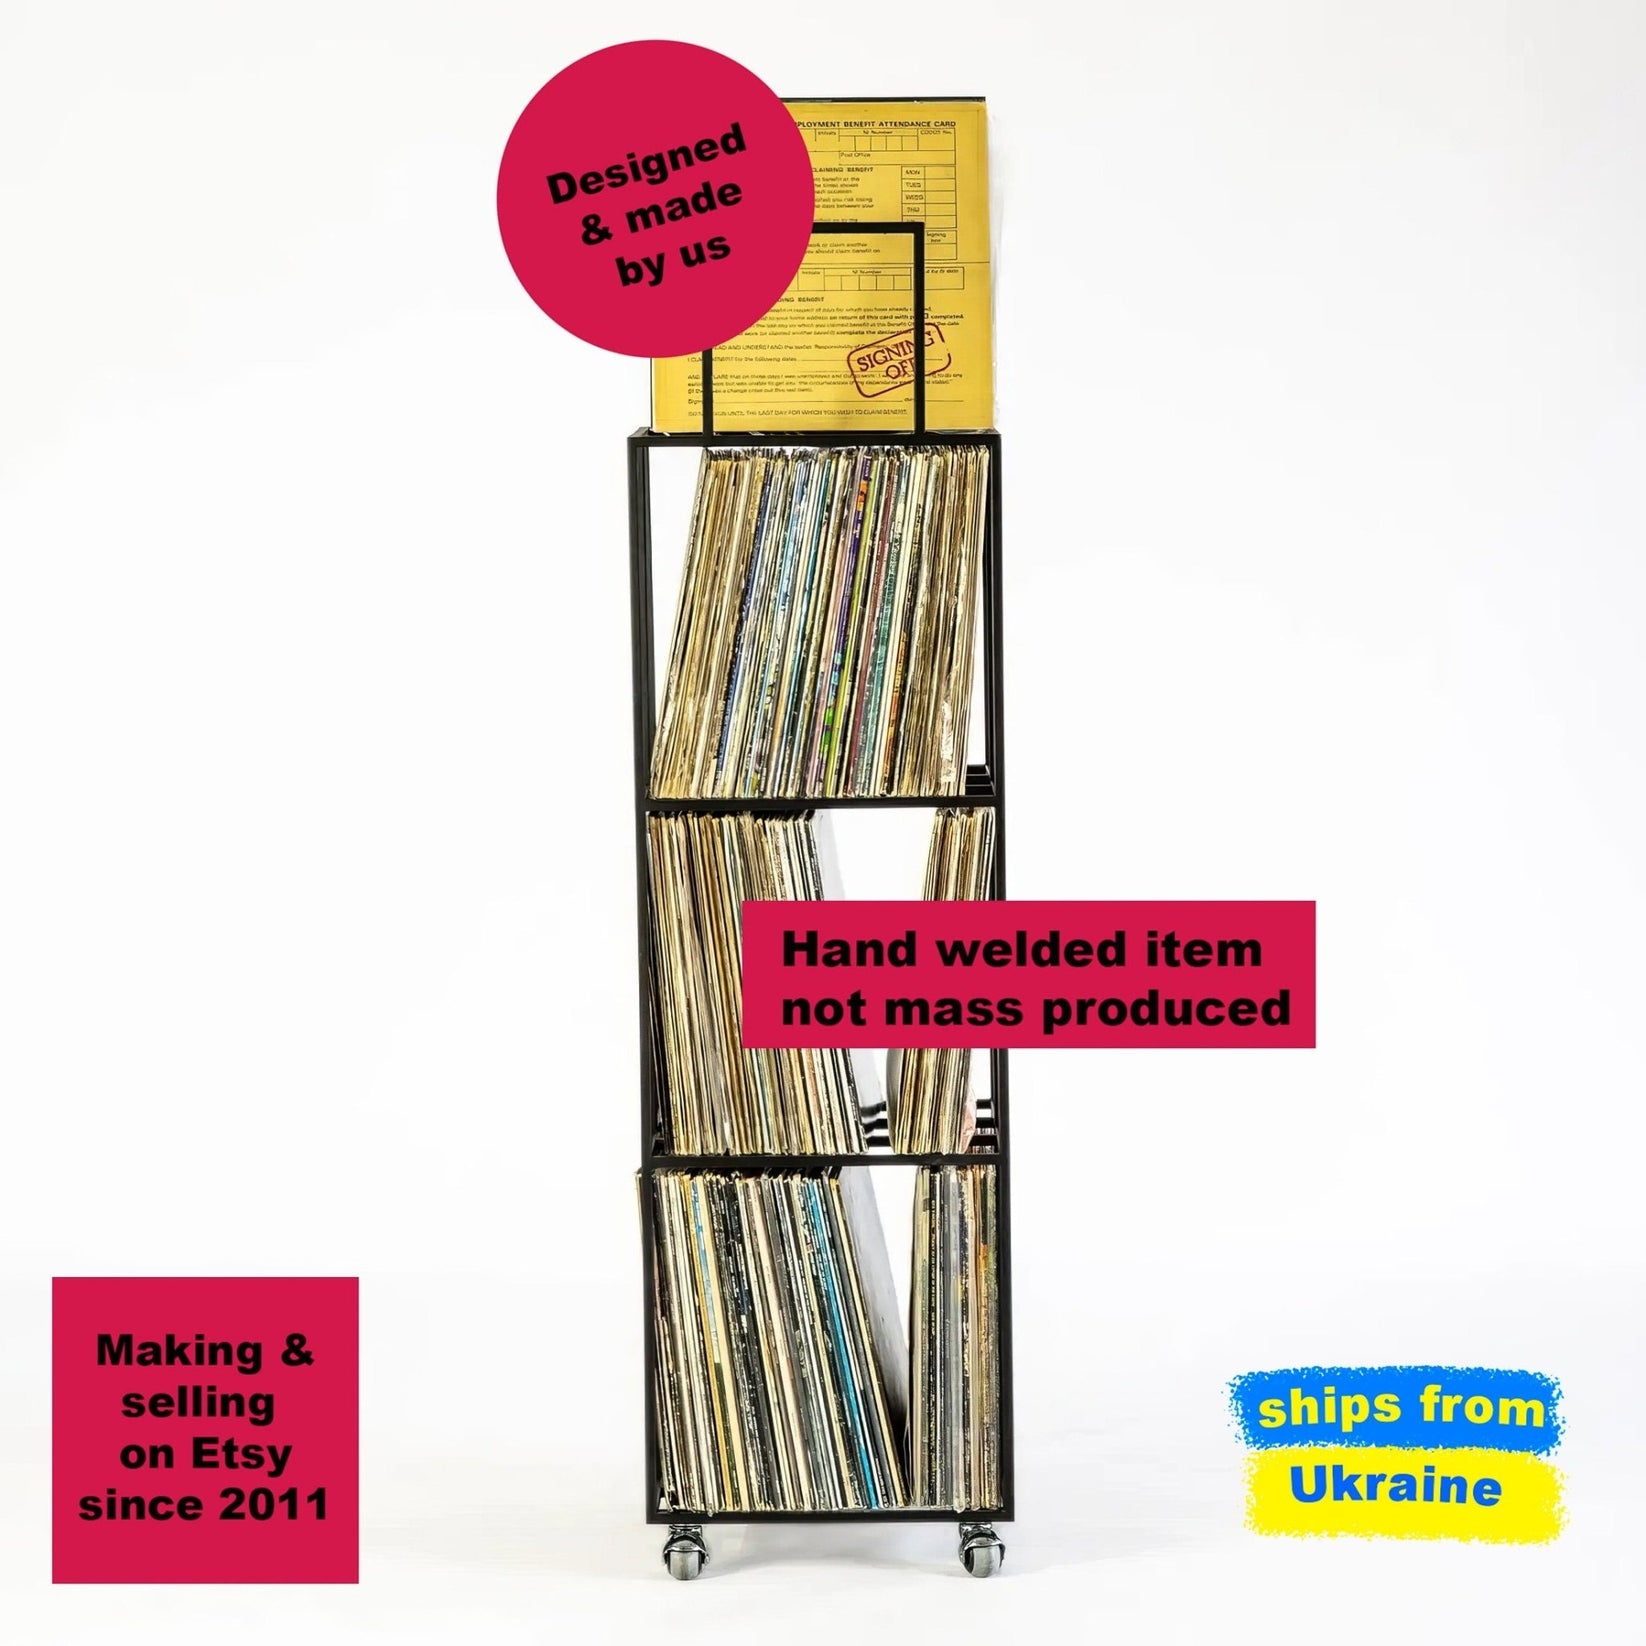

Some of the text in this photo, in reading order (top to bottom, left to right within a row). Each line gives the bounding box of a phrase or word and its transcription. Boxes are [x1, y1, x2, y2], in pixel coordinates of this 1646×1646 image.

[796, 120, 956, 128] PLOYMENT BENEFIT ATTENDANCE CARD
